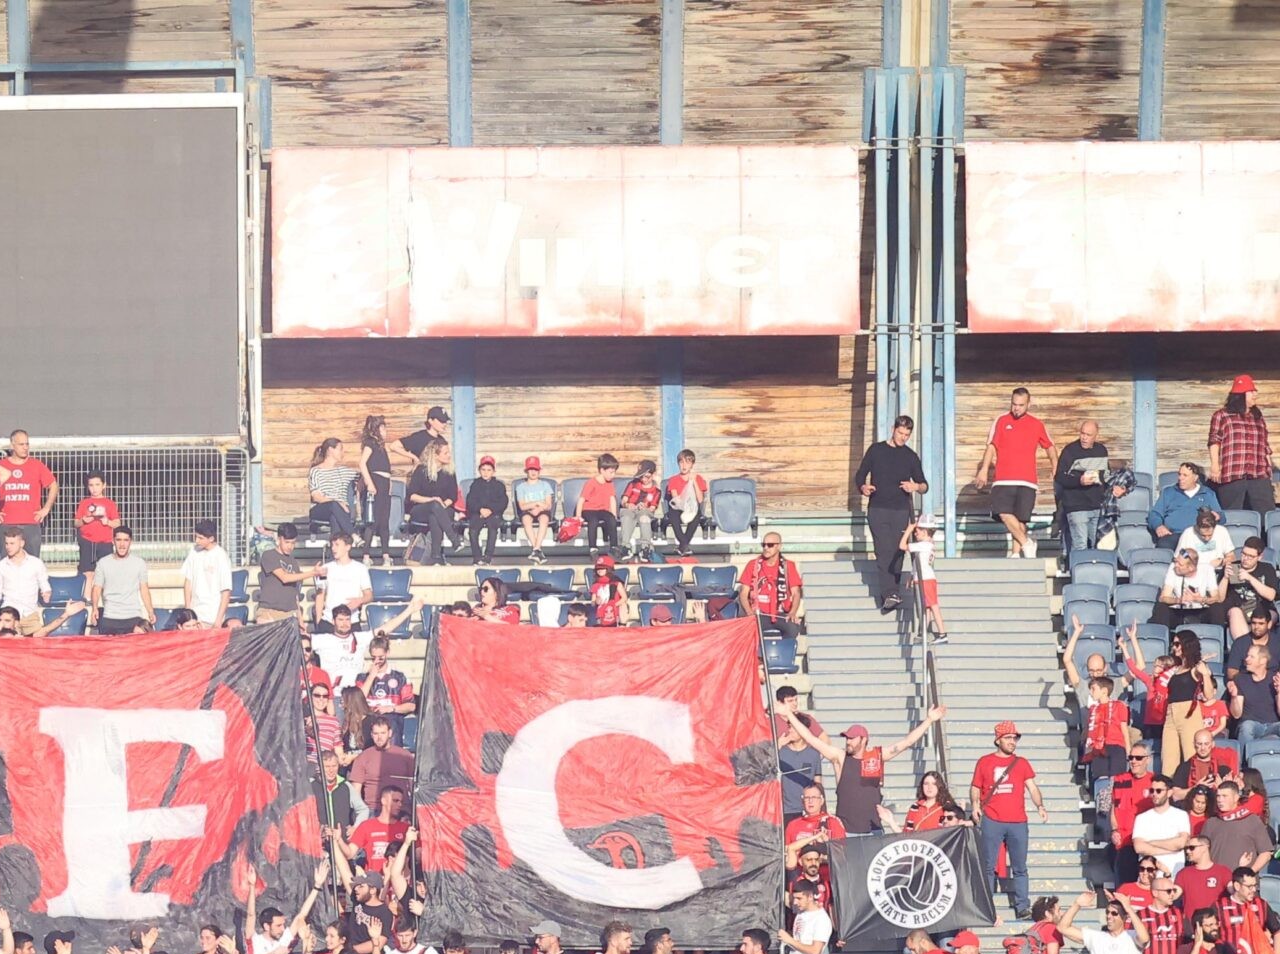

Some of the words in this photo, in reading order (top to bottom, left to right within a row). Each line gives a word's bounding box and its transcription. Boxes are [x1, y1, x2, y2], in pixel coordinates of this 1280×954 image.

[4, 483, 30, 491] אהבה
[39, 705, 226, 921] F
[495, 695, 704, 911] C
[871, 852, 892, 882] LOVE
[893, 843, 951, 877] FOOTBALL
[879, 899, 908, 924] HATE
[913, 894, 951, 925] RACISM
